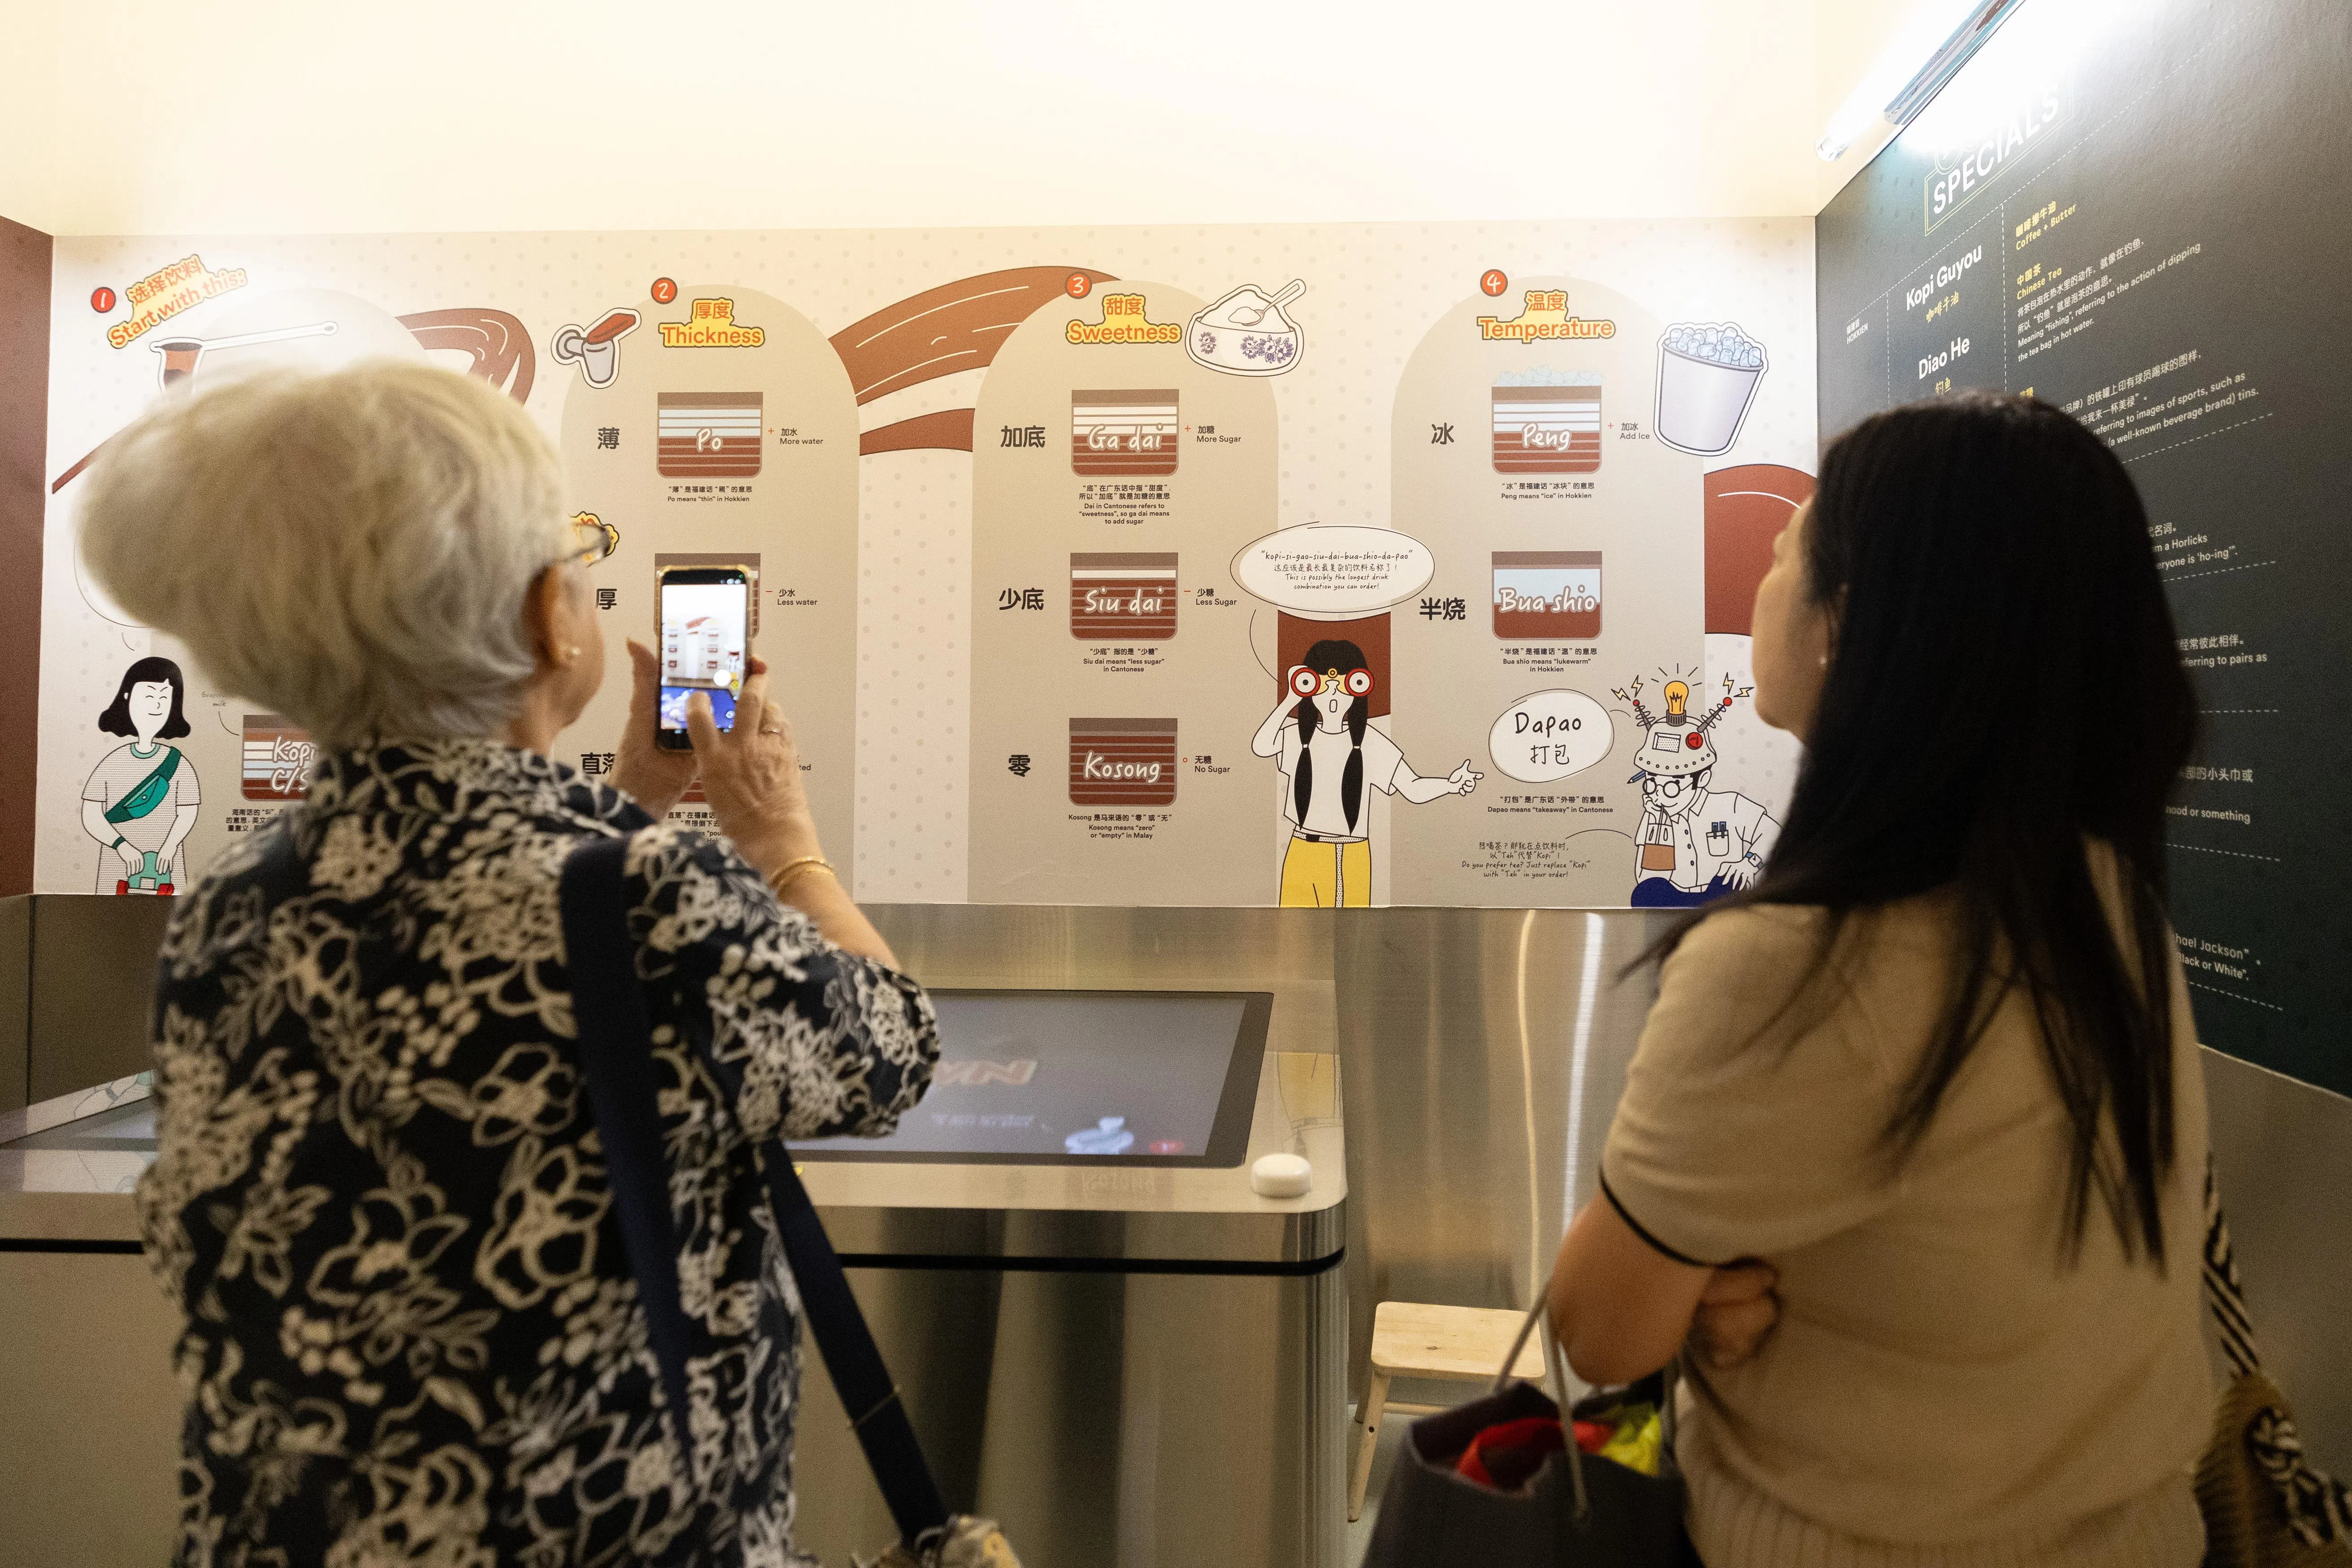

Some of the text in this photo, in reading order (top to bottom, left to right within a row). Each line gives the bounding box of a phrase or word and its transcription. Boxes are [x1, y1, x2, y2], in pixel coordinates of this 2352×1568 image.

[1933, 83, 2059, 214] SPECIALS
[2016, 204, 2076, 251] Coffee Butter
[131, 258, 201, 306] 选择饮料
[1906, 245, 1983, 311] Kopi Guyou
[2017, 263, 2041, 286] 中国茶
[2017, 267, 2062, 300] Chinese Tea
[658, 283, 668, 299] 2
[1073, 278, 1084, 294] 3
[2018, 243, 2201, 348] Meaning referring to the action of dipping
[111, 272, 244, 345] Start with this:
[694, 301, 731, 320] 厚度
[1106, 297, 1142, 316] 甜度
[1527, 292, 1567, 312] 温度
[1925, 291, 1960, 324] 咖啡牛油
[662, 326, 762, 344] Thickness
[1069, 323, 1179, 342] Sweetness
[1480, 319, 1613, 340] Temperature
[2040, 318, 2095, 353] bag hot water.
[1919, 336, 1970, 380] Diao He
[1935, 377, 1951, 395] 钓鱼
[2093, 372, 2246, 435] referring to images of sports, such as
[1621, 422, 1639, 431] 加冰
[2116, 387, 2259, 445] well-known beverage brand) tins.
[598, 427, 620, 450] 薄
[781, 428, 798, 436] 加水
[1000, 425, 1046, 449] 加底
[1089, 424, 1163, 452] Ga dai
[1198, 425, 1215, 434] 加糖
[1219, 435, 1241, 444] Sugar
[1431, 422, 1454, 445] 冰
[1523, 423, 1571, 451] Peng
[1620, 432, 1650, 440] Add Ice
[698, 429, 722, 452] Po
[2172, 534, 2208, 549] Horlicks
[2187, 554, 2196, 564] is
[1309, 573, 1332, 582] possibly
[1348, 573, 1370, 582] longest
[596, 588, 618, 610] 厚
[779, 588, 796, 597] 少水
[999, 587, 1045, 611] 少底
[1085, 586, 1163, 613] Siu dai
[1197, 588, 1215, 597] 少糖
[1215, 598, 1237, 607] Sugar
[1499, 585, 1596, 612] Bua shio
[1419, 597, 1466, 621] 半烧
[2217, 652, 2268, 667] to pairs as
[1514, 712, 1582, 738] Dapao
[1194, 756, 1212, 764] 无糖
[1530, 744, 1570, 765] 打包
[1008, 754, 1031, 777] 零
[1084, 751, 1160, 784] Kosong
[1208, 765, 1231, 774] Sugar
[2190, 808, 2251, 825] or something
[1544, 861, 1567, 869] replace
[2202, 962, 2212, 970] or
